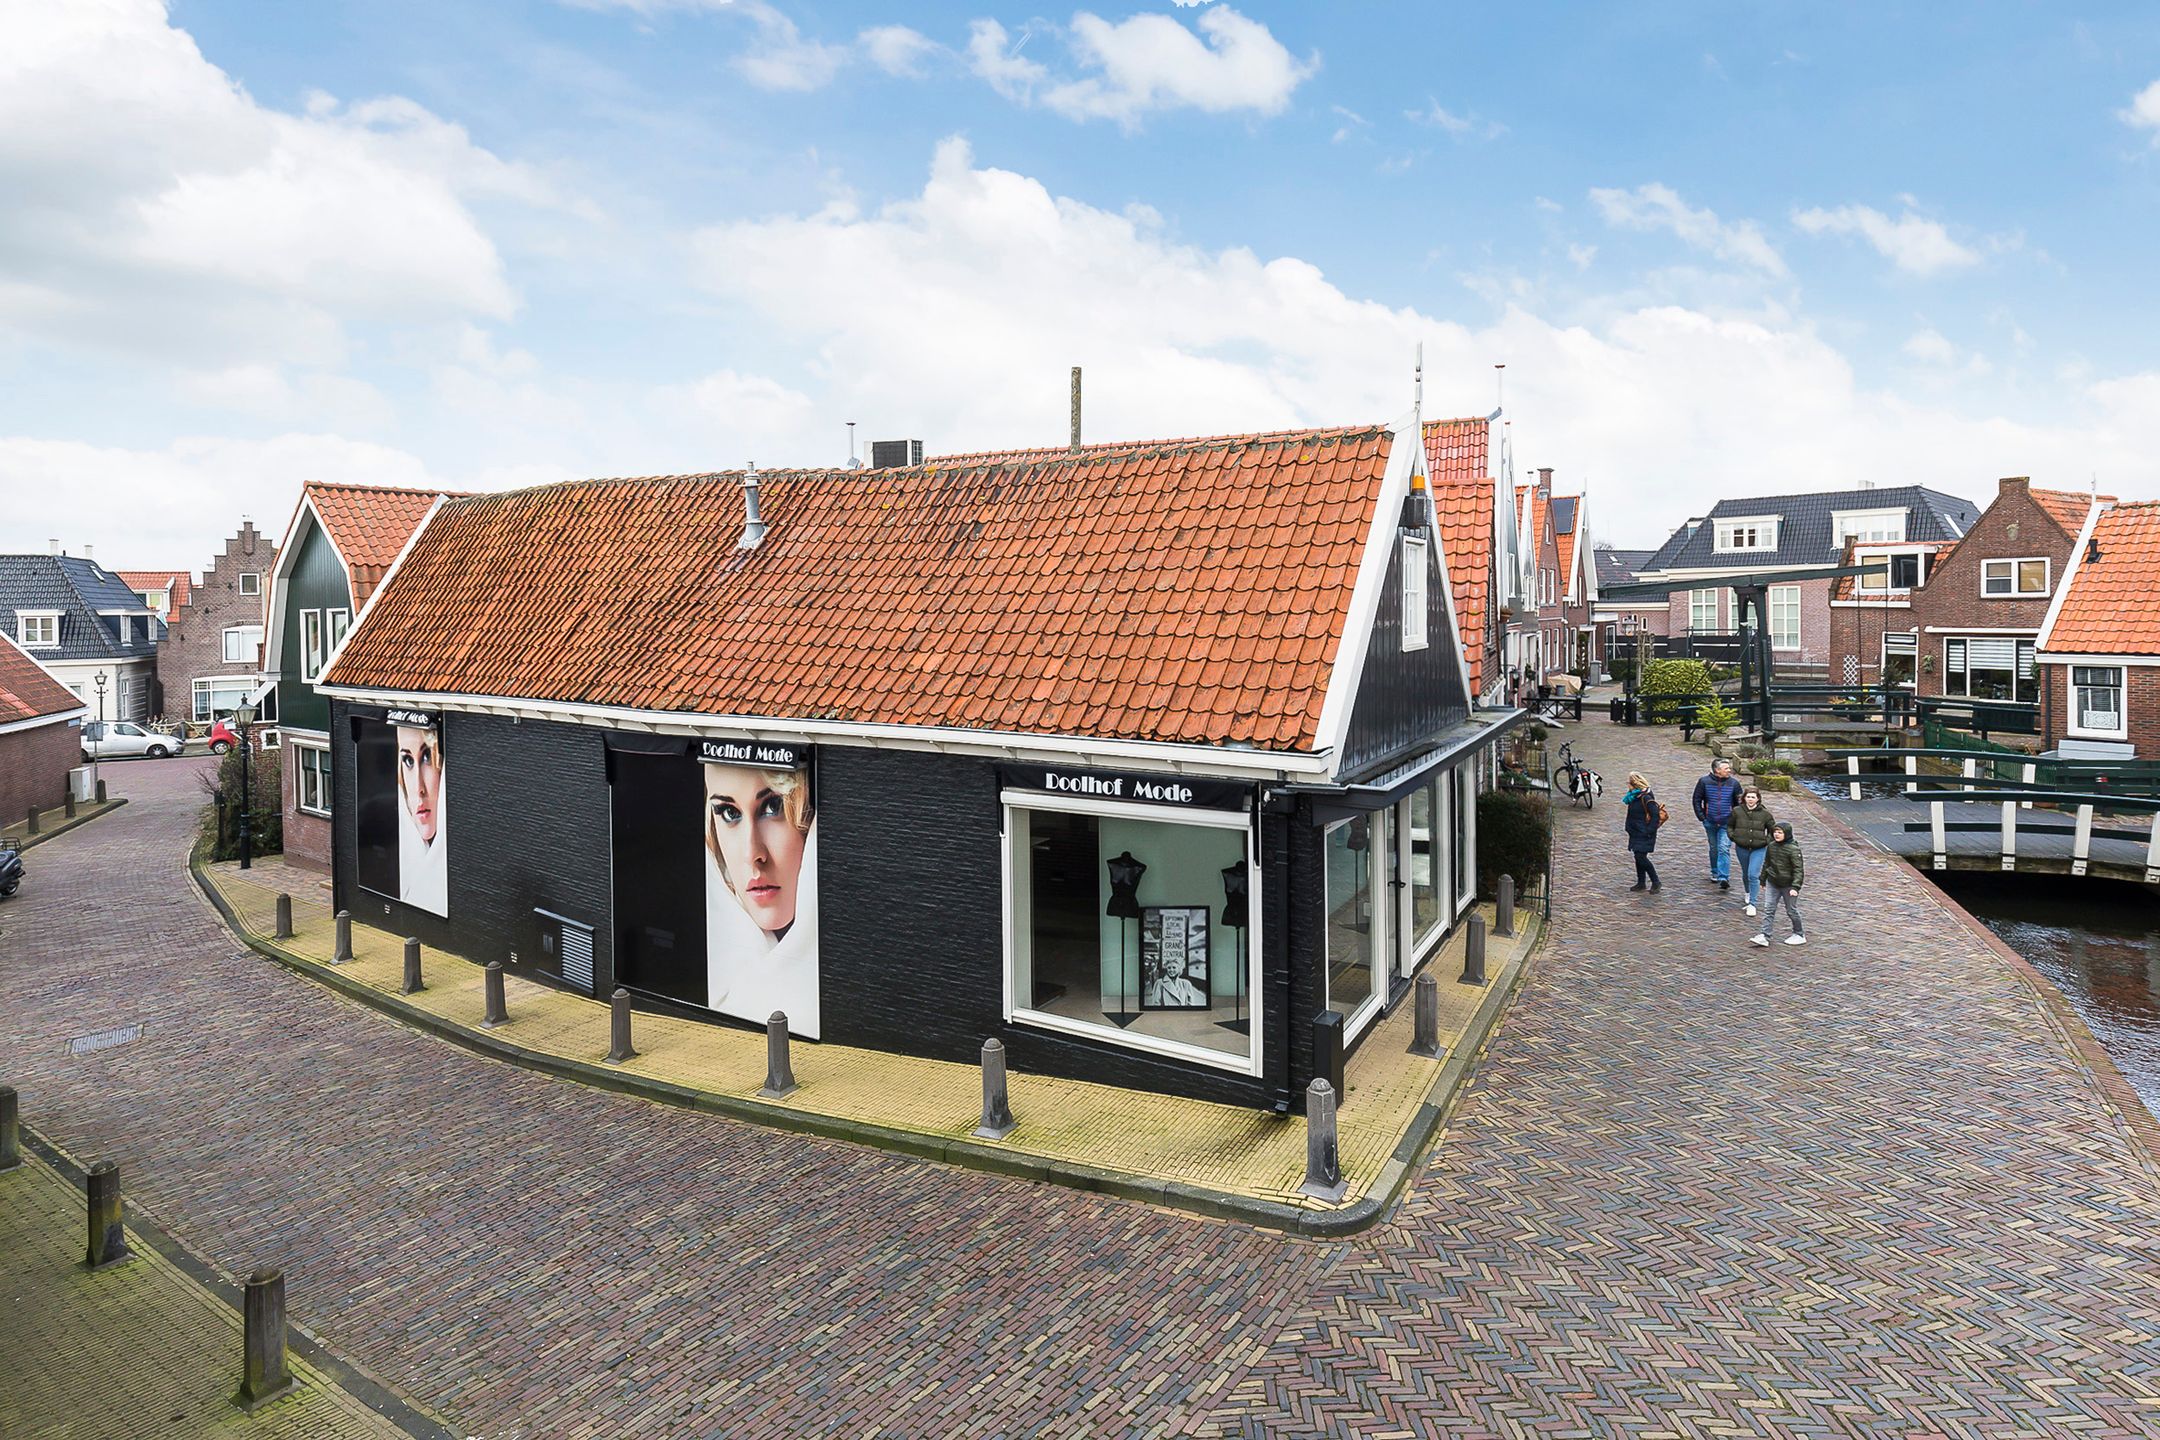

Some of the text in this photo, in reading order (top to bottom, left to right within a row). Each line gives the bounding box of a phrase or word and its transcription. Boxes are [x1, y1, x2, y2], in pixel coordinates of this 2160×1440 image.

[703, 742, 793, 762] Doolhof Mode
[1045, 773, 1193, 803] Doolhof Mode
